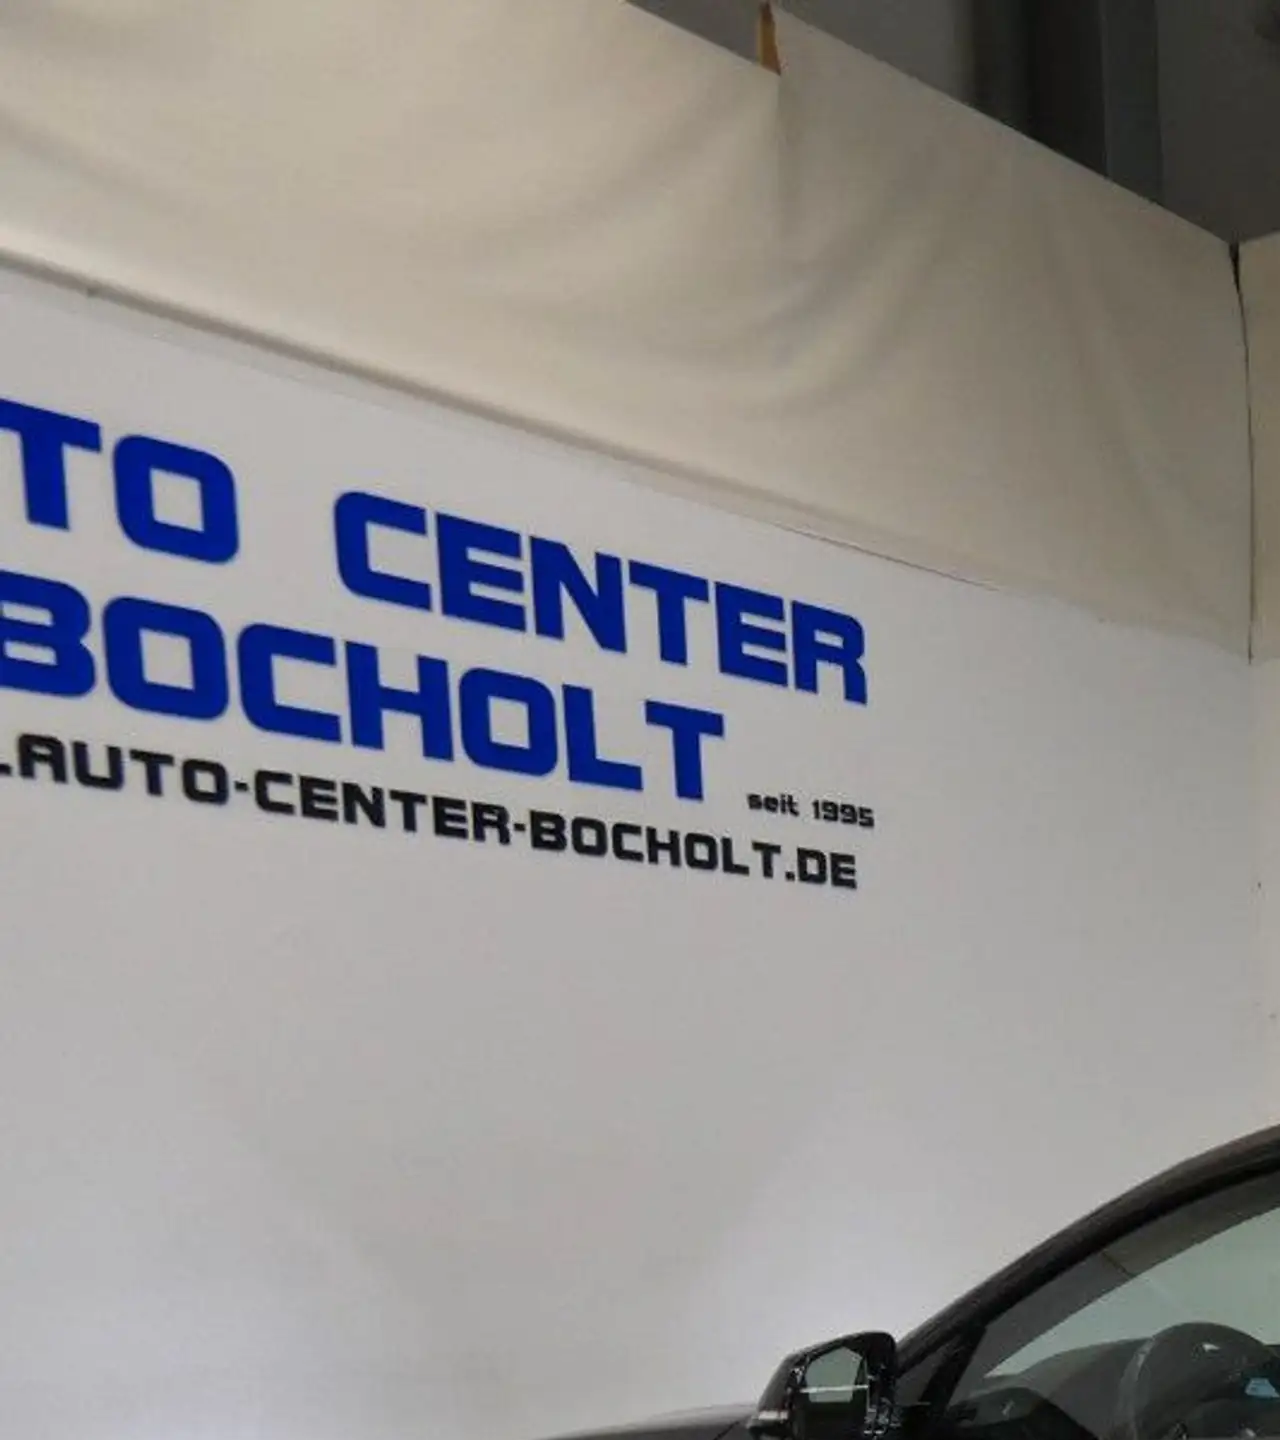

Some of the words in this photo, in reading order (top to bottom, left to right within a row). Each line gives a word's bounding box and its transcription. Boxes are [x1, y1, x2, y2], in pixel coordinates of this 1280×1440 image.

[0, 570, 724, 801] BOCHOLT
[747, 793, 800, 818] seit
[811, 799, 876, 829] 1995
[334, 491, 868, 704] CENTER
